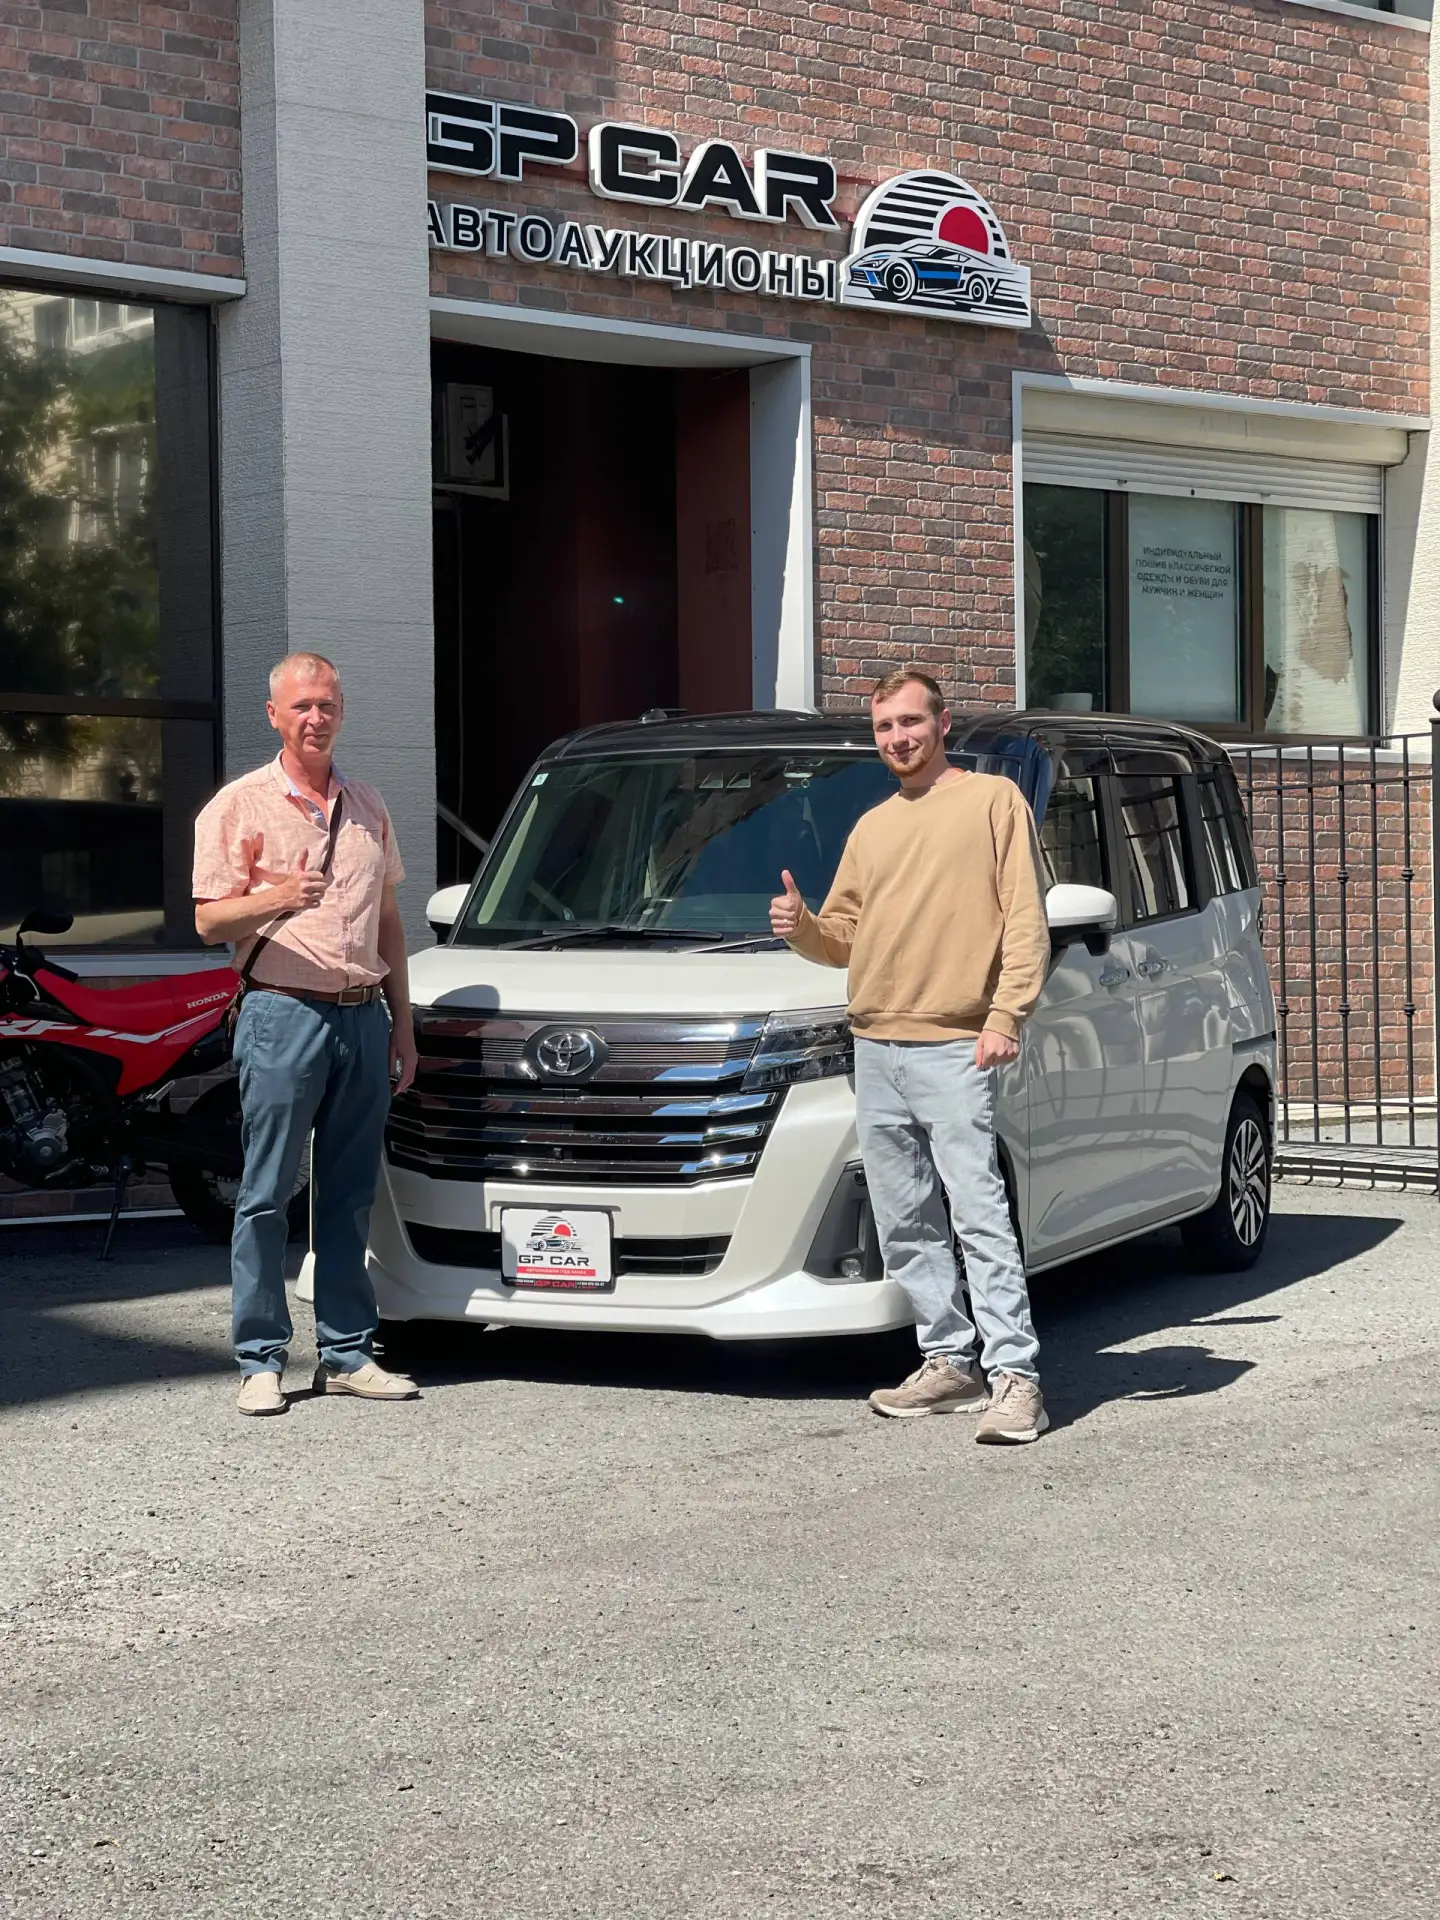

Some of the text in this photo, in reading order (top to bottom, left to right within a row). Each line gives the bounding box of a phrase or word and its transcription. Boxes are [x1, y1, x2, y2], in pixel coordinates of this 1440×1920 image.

[426, 90, 842, 233] GP CAR
[427, 199, 838, 303] АВТОАУКЦИОНЫ
[1143, 547, 1222, 560] ИНДИВИДУАЛЬНЫЙ
[1135, 559, 1231, 574] ПОШИВ КЛАССИЧЕСКОЙ
[1136, 572, 1228, 588] ОДЕЖДЫ И ОБУВИ ДЛЯ
[1141, 586, 1224, 600] МУЖЧИН И ЖЕНЩИН
[186, 991, 230, 1009] HONDA
[518, 1255, 590, 1266] GP CAR
